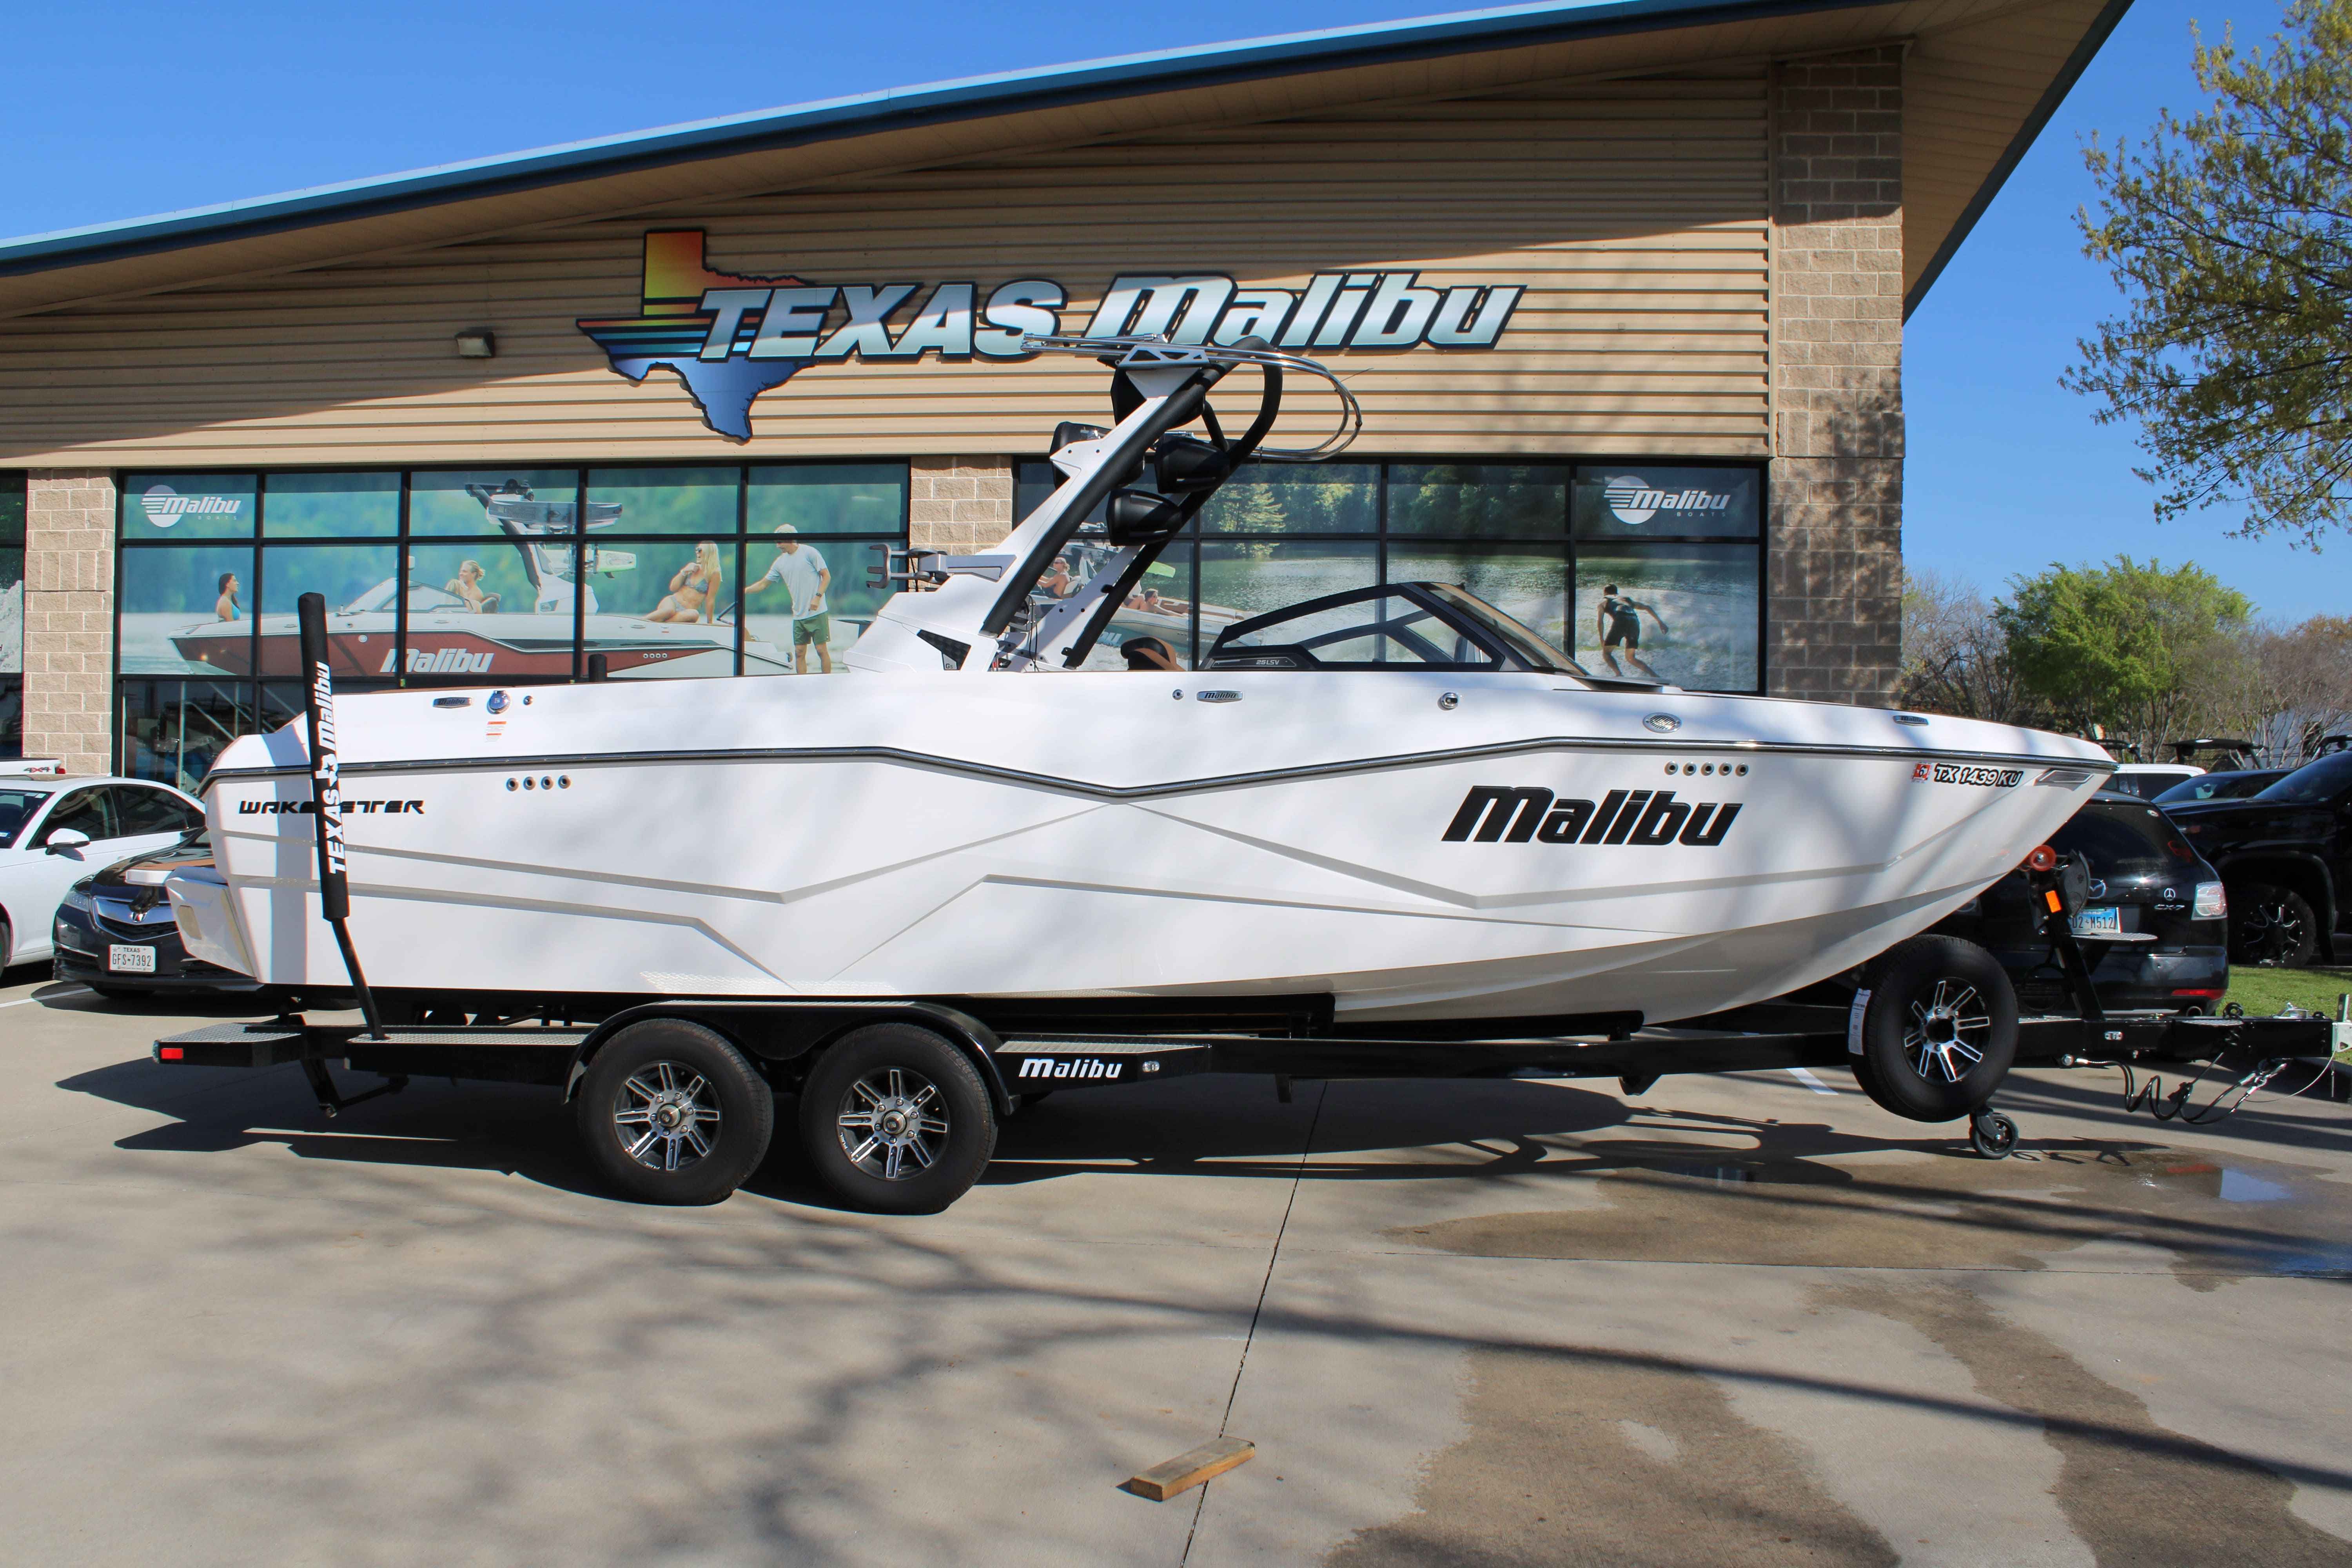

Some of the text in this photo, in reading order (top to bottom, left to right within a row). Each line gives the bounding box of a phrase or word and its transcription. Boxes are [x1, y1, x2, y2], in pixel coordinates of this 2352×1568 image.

[698, 272, 1526, 361] TEXAS Malibu
[162, 497, 241, 513] Malibu
[1629, 490, 1731, 509] Malibu
[379, 648, 494, 672] Malibu
[314, 661, 347, 874] TEXAS Malibu
[1934, 764, 2024, 787] TX 1439 KU
[239, 800, 425, 814] WAKEETTER
[1441, 785, 1743, 846] Malibu
[1019, 1058, 1123, 1078] Malibu
